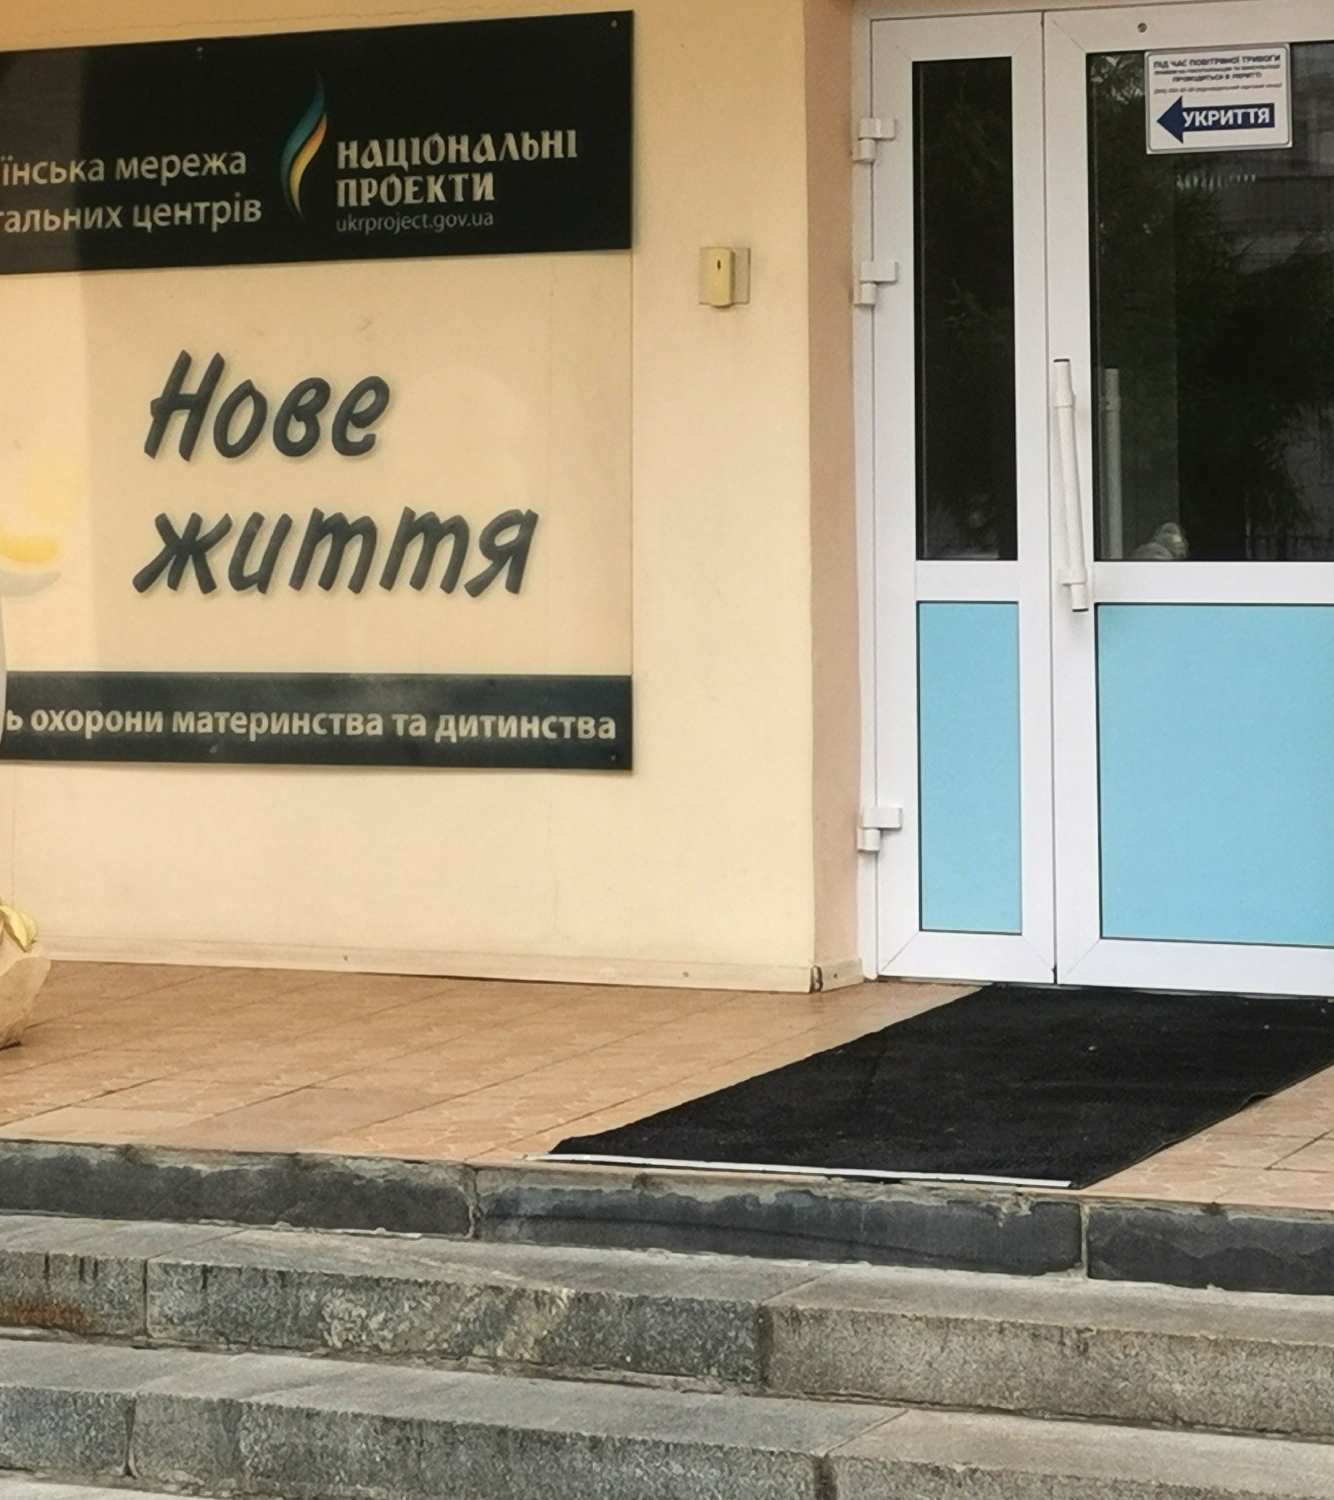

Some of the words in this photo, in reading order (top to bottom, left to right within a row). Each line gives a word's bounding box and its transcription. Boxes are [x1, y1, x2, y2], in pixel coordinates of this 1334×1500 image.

[1182, 107, 1271, 128] УКРИТТЯ
[115, 147, 247, 188] мережа
[336, 128, 578, 173] НАЦІОНАЛЬНІ
[335, 171, 496, 208] ПРОЕКТИ
[132, 192, 263, 233] центрів
[335, 208, 495, 237] ukrproject.gov.ua
[142, 349, 391, 462] Нове
[131, 504, 540, 599] життя
[30, 710, 164, 741] охорони
[171, 713, 384, 741] материнства
[391, 714, 427, 738] та
[434, 712, 618, 745] дитинства
